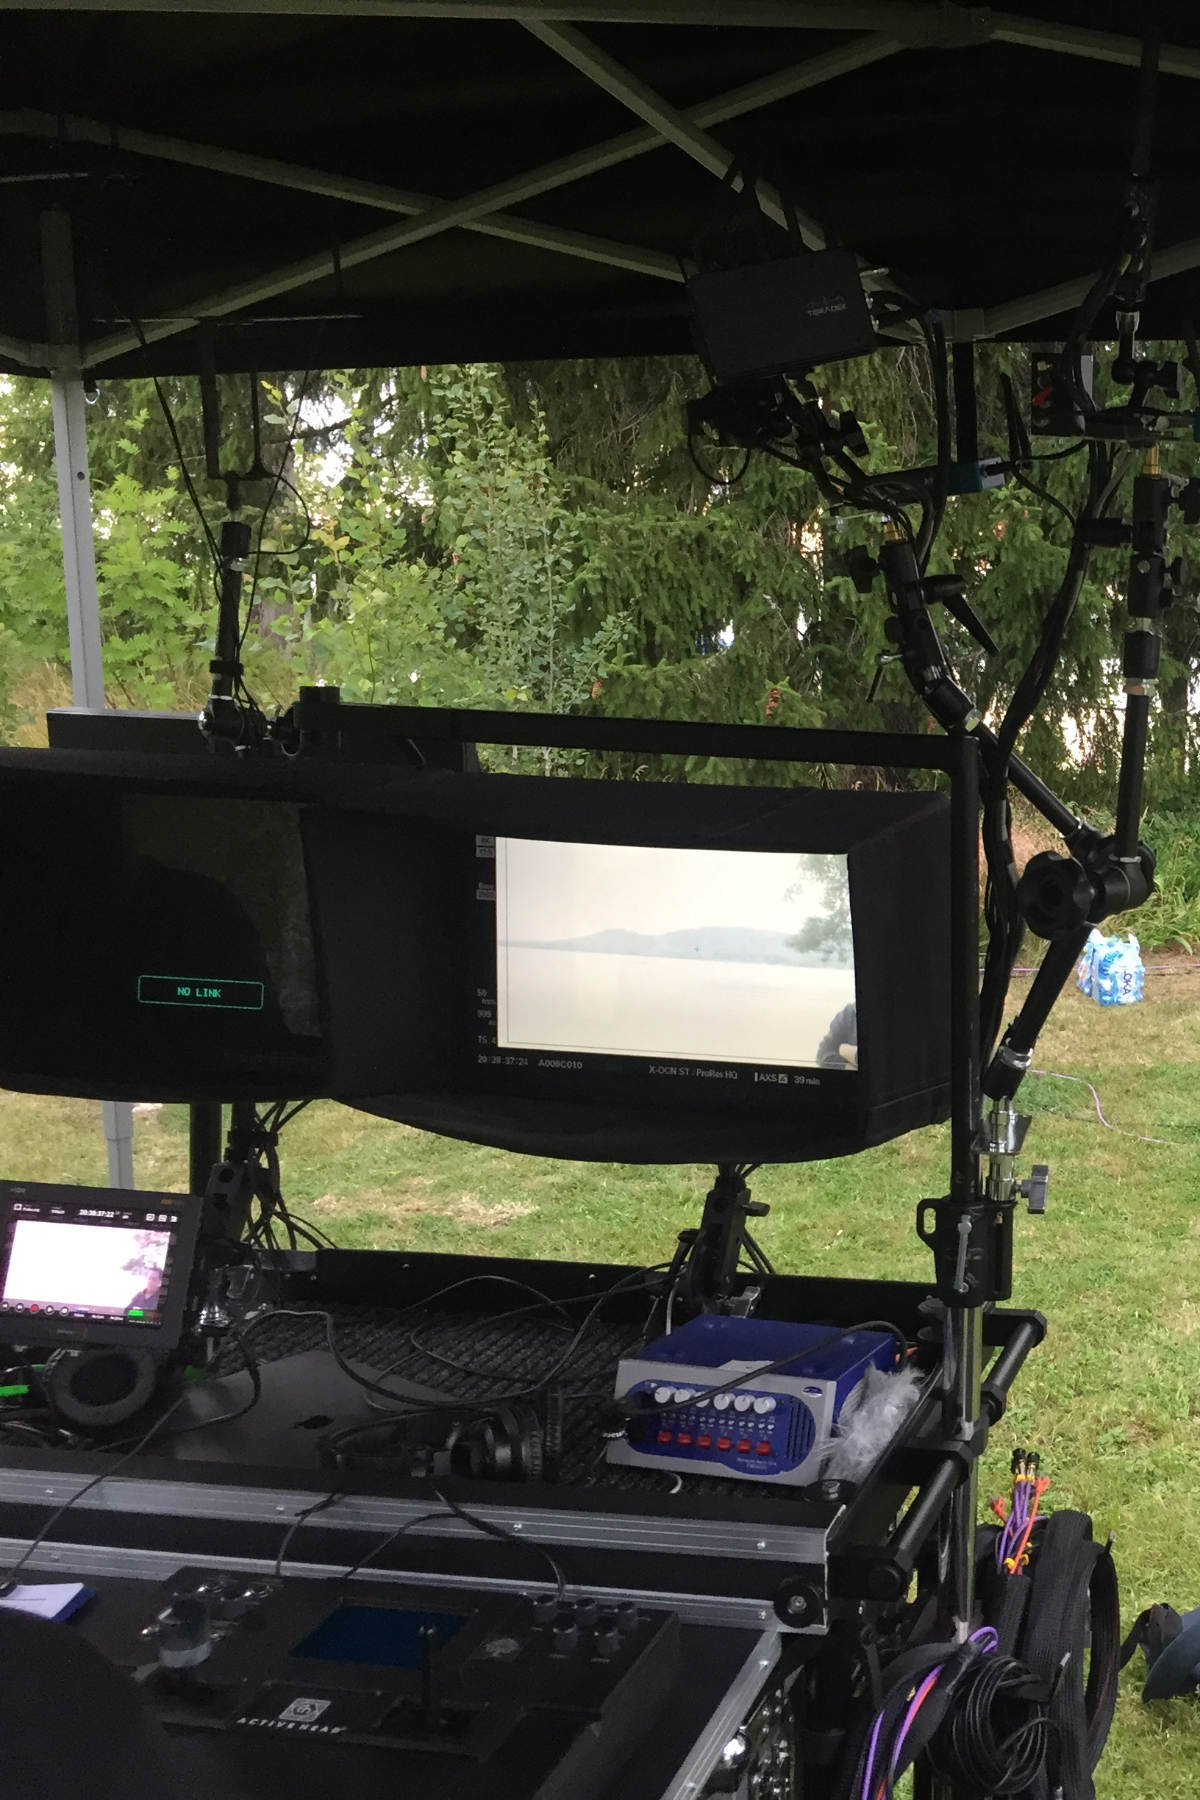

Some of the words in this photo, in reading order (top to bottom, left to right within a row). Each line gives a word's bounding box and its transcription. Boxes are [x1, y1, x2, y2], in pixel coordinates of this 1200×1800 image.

[1122, 969, 1133, 996] LOKA
[177, 987, 191, 996] NO
[195, 988, 222, 998] LINK
[649, 1065, 677, 1075] X-OCN
[679, 1068, 690, 1076] ST
[696, 1069, 723, 1079] ProRes
[725, 1071, 738, 1080] HQ
[759, 1073, 778, 1083] AXS
